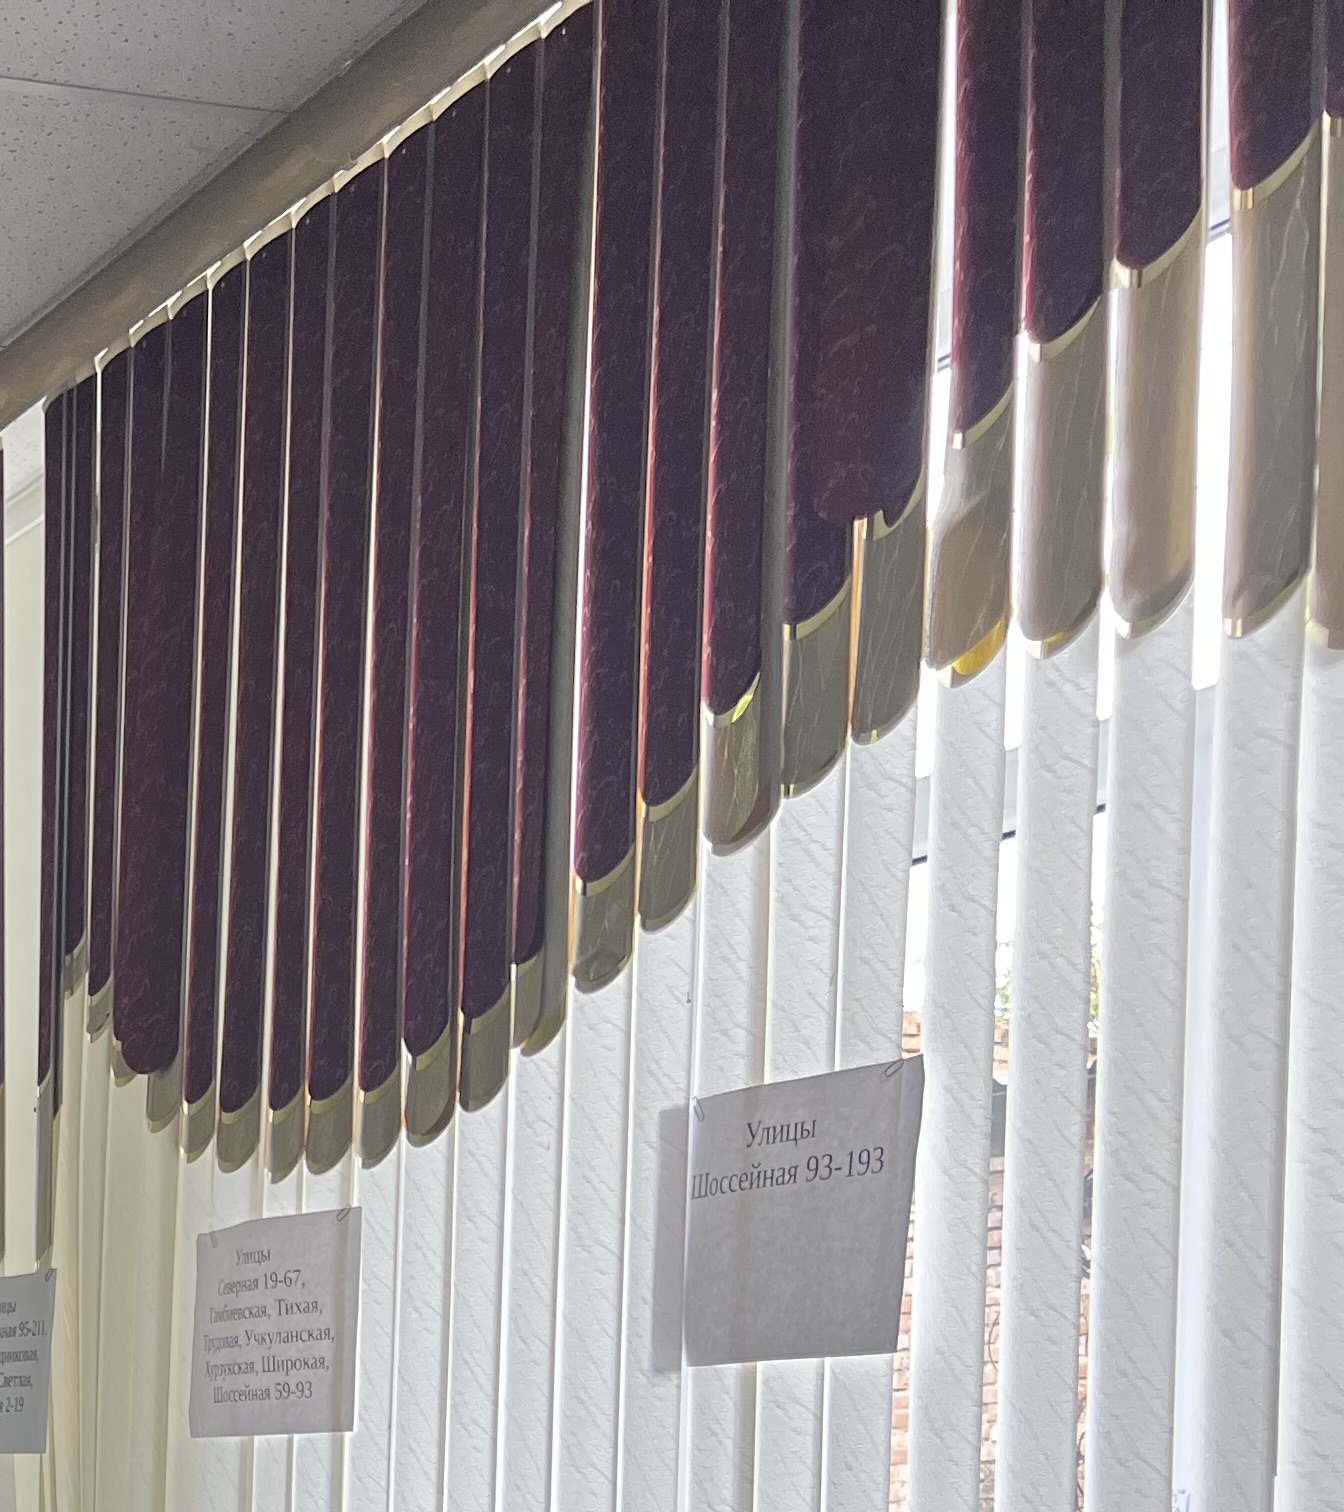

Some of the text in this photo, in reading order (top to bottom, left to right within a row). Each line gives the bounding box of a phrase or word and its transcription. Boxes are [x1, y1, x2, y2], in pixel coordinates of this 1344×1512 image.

[746, 1119, 817, 1149] Улицы
[690, 1146, 885, 1200] Шоссейная 93-193
[235, 1249, 271, 1266] Улицы
[217, 1269, 306, 1298] Северная 19-67,
[274, 1298, 323, 1318] Тихая,
[244, 1326, 336, 1351] Учкуланская,
[262, 1355, 330, 1376] Широкая,
[213, 1381, 313, 1404] Шоссейная 59-93
[5, 1396, 25, 1413] 2-19
